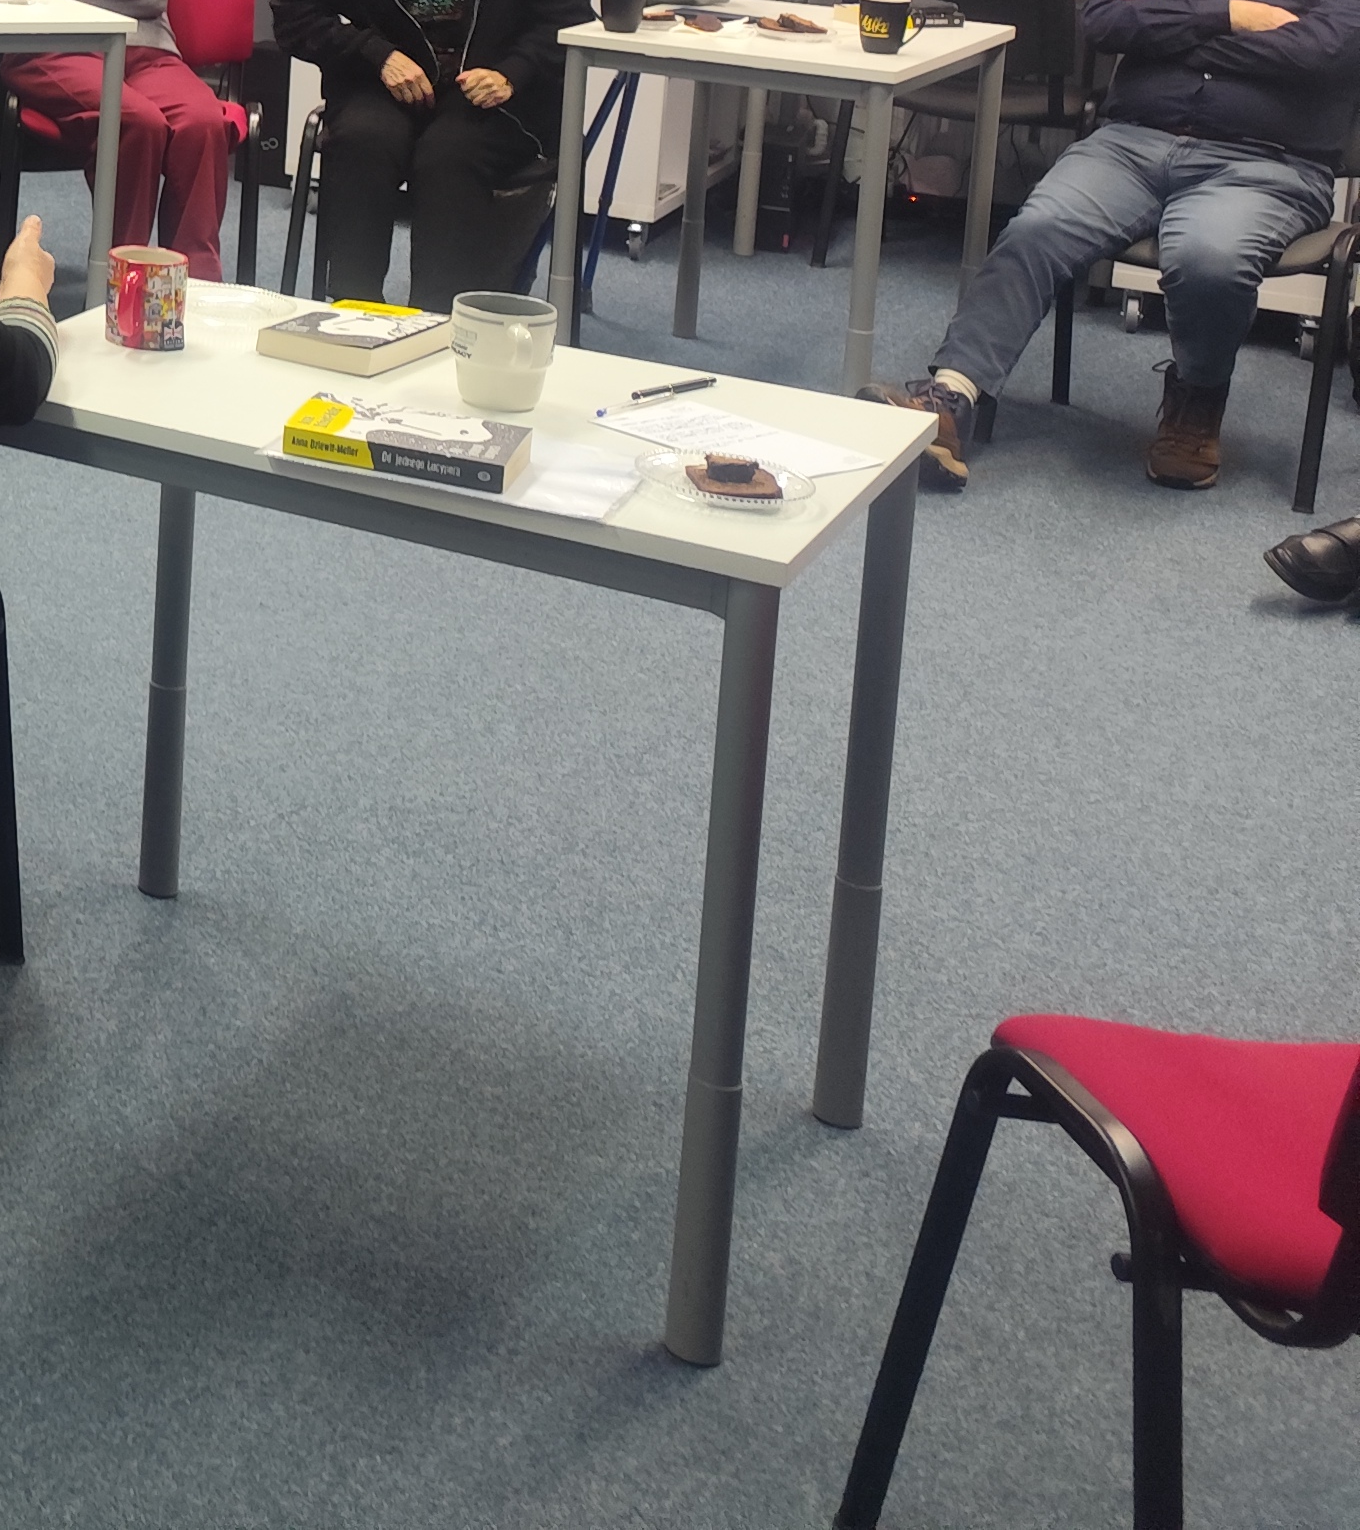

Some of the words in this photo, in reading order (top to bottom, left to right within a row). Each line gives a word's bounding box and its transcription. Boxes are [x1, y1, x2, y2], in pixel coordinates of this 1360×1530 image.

[291, 436, 308, 448] Anna
[310, 439, 359, 457] Dziewit-Meller
[381, 450, 392, 464] Od
[395, 453, 425, 471] jednego
